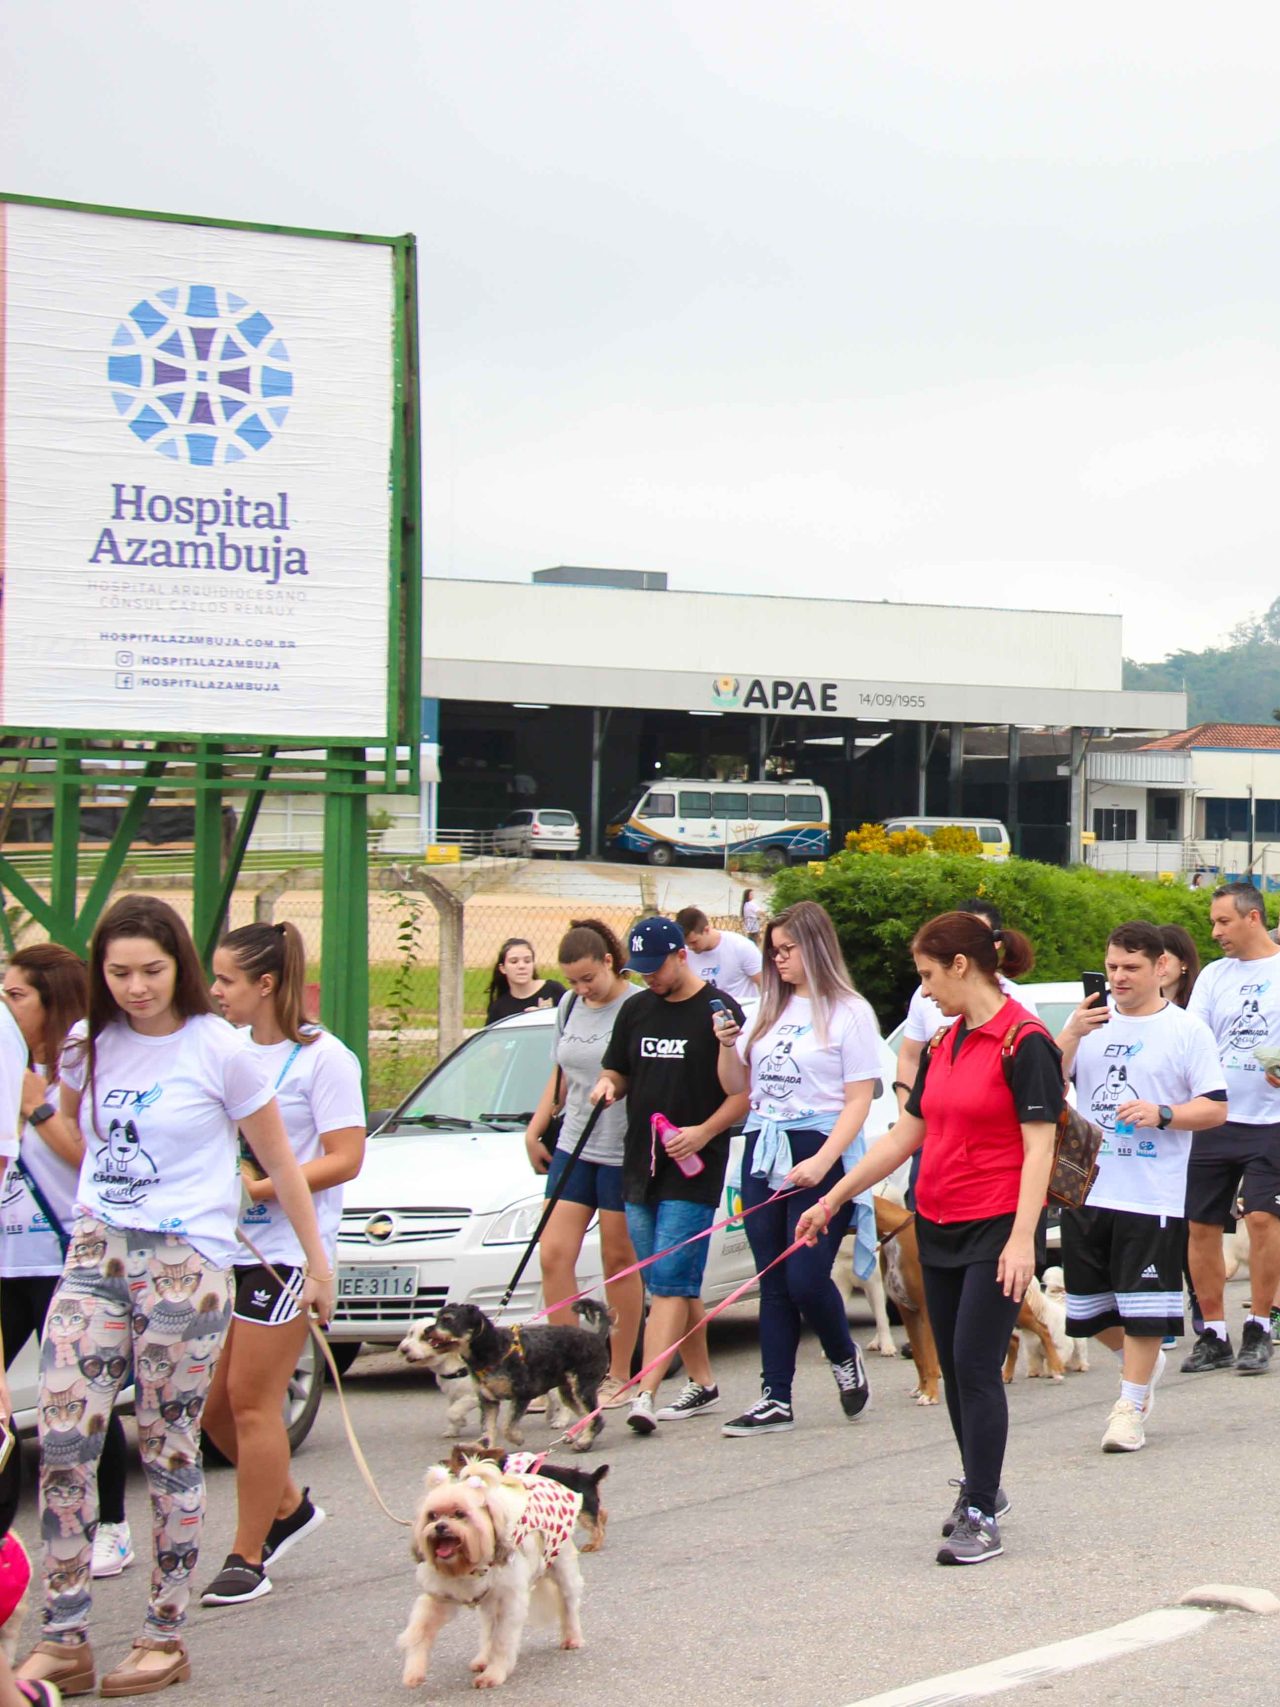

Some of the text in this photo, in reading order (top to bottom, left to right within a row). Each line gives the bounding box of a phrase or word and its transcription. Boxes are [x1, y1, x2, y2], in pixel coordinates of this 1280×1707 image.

[111, 483, 290, 536] Hospital
[88, 527, 309, 584] Azambuja
[88, 579, 165, 596] HOSPITAL
[234, 604, 296, 617] RENAUX
[99, 631, 297, 649] HOSPITALAZAMBUJA.COM.BR
[743, 679, 926, 712] APAE 14/09/1955
[656, 1039, 688, 1054] QIX
